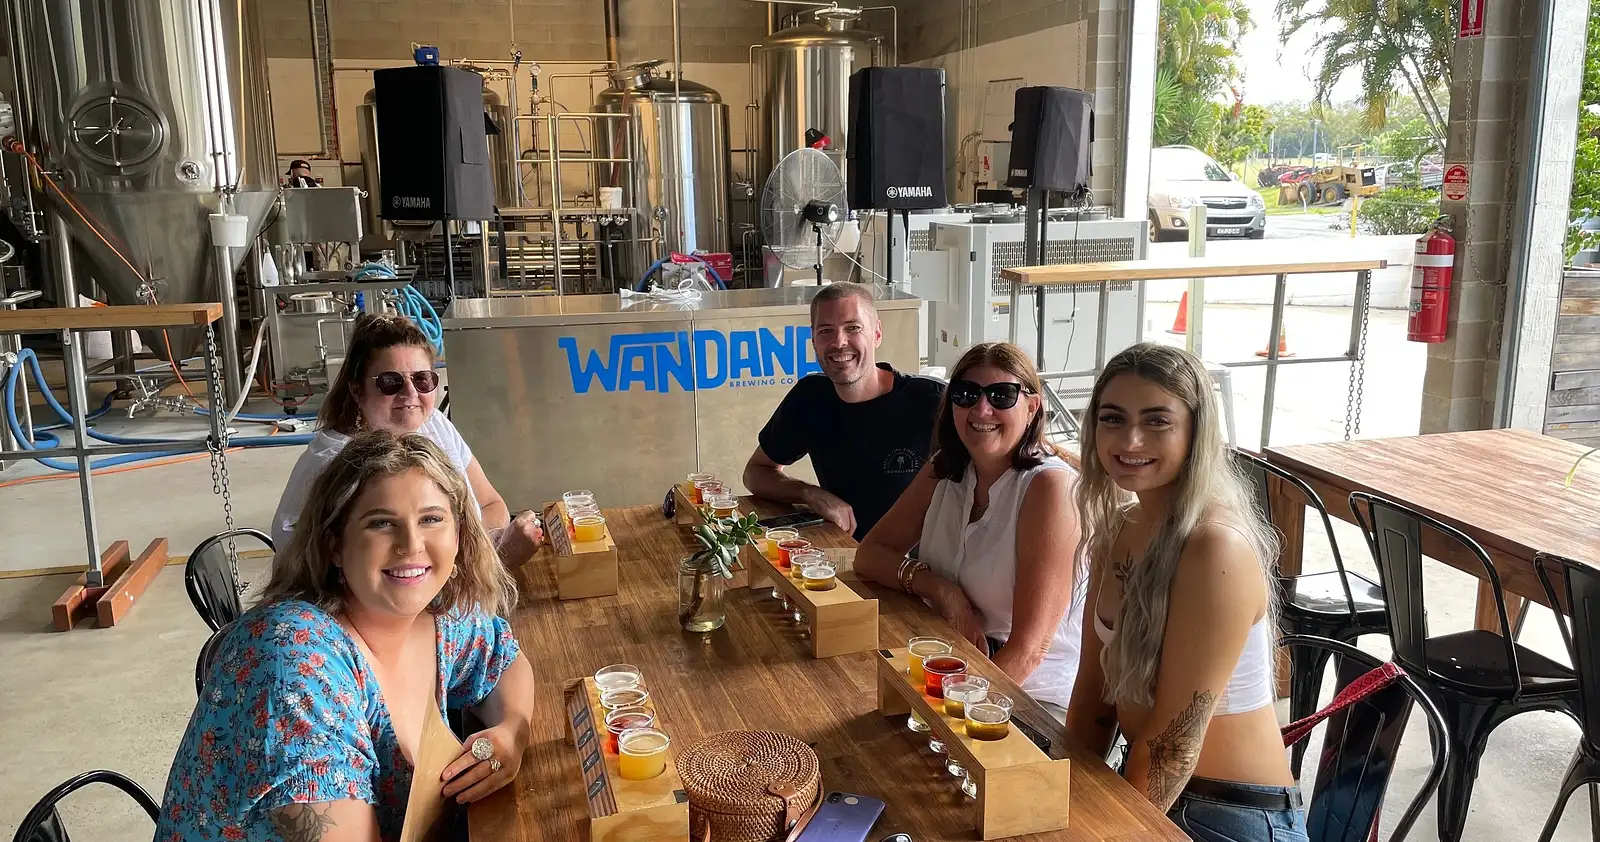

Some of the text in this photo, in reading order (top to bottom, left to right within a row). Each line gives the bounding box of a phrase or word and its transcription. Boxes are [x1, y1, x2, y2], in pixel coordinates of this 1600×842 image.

[897, 186, 933, 197] YAMAHA
[402, 196, 431, 208] YAMAHA
[729, 377, 797, 388] BREWING CO.
